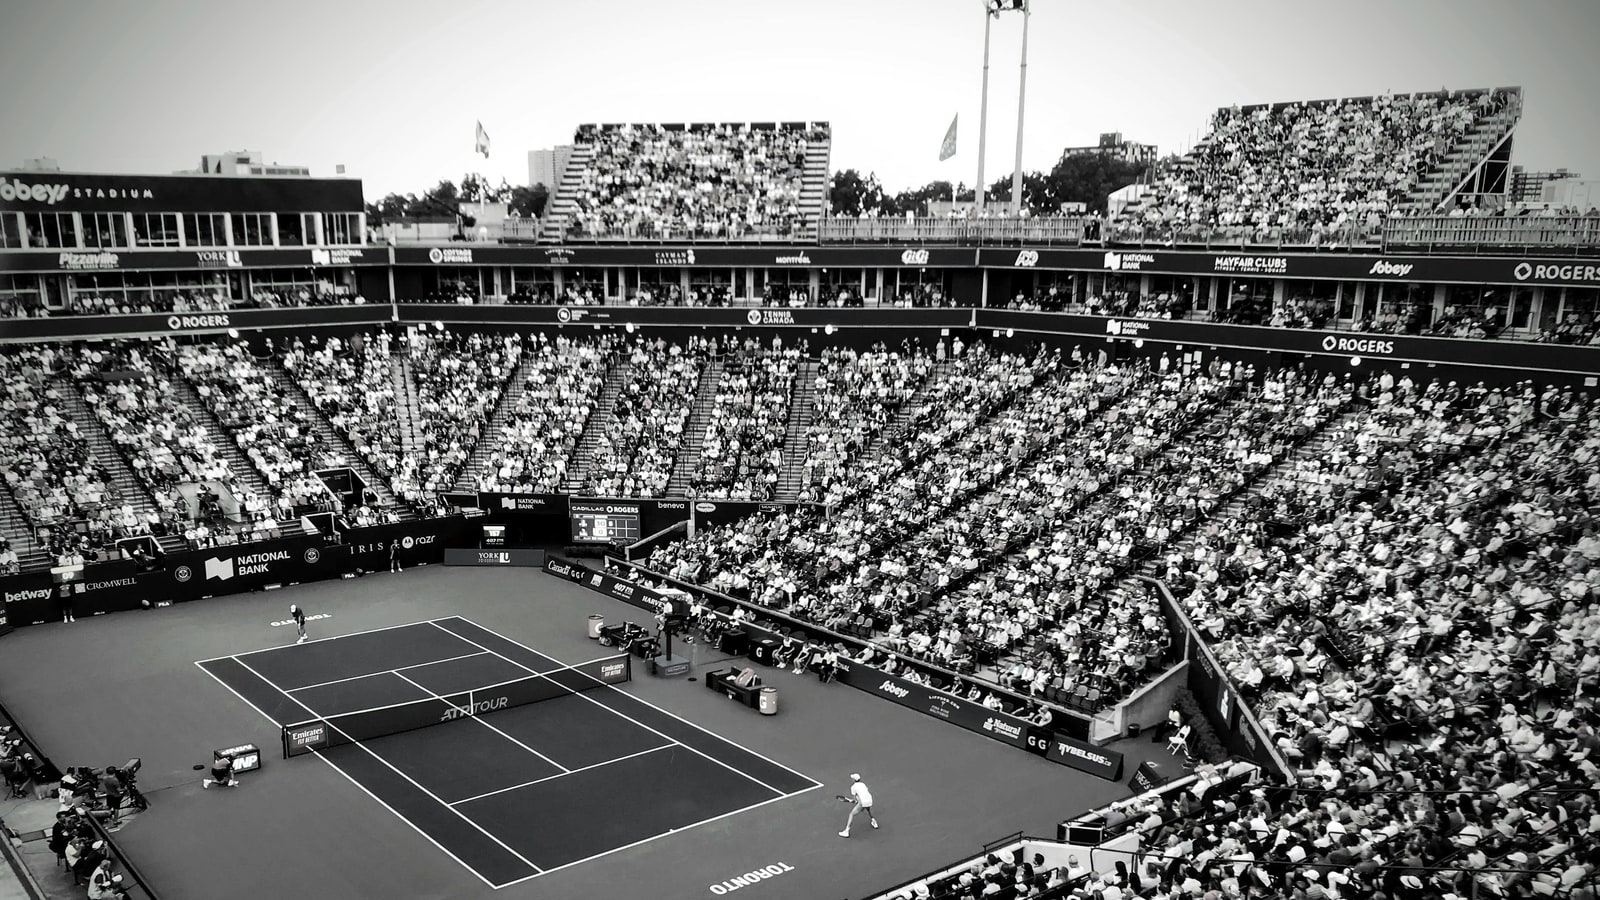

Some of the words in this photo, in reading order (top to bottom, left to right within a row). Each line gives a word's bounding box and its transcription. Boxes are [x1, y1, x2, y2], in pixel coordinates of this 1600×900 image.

[0, 177, 69, 205] obeys
[74, 187, 153, 198] STADIUM
[197, 252, 226, 262] YORK
[1122, 254, 1154, 263] NATIONAL
[1215, 257, 1253, 267] MAYFAIR
[1255, 258, 1287, 268] CLUBS
[1122, 261, 1140, 270] BANK
[1535, 265, 1600, 280] ROGERS
[183, 315, 230, 328] ROGERS
[1122, 322, 1150, 330] NATIONAL
[1338, 339, 1394, 354] ROGERS
[613, 506, 639, 514] ROGERS
[415, 535, 436, 545] razr
[350, 542, 384, 554] IRIS
[237, 550, 291, 566] NATIONAL
[238, 563, 269, 576] BANK
[548, 560, 571, 575] Canada
[86, 578, 137, 591] CROMWELL
[5, 588, 52, 602] betway
[440, 703, 470, 721] ATP
[473, 696, 509, 714] TOUR
[292, 727, 324, 740] Emirates
[993, 718, 1021, 736] Natural
[709, 861, 795, 895] TORONTO
